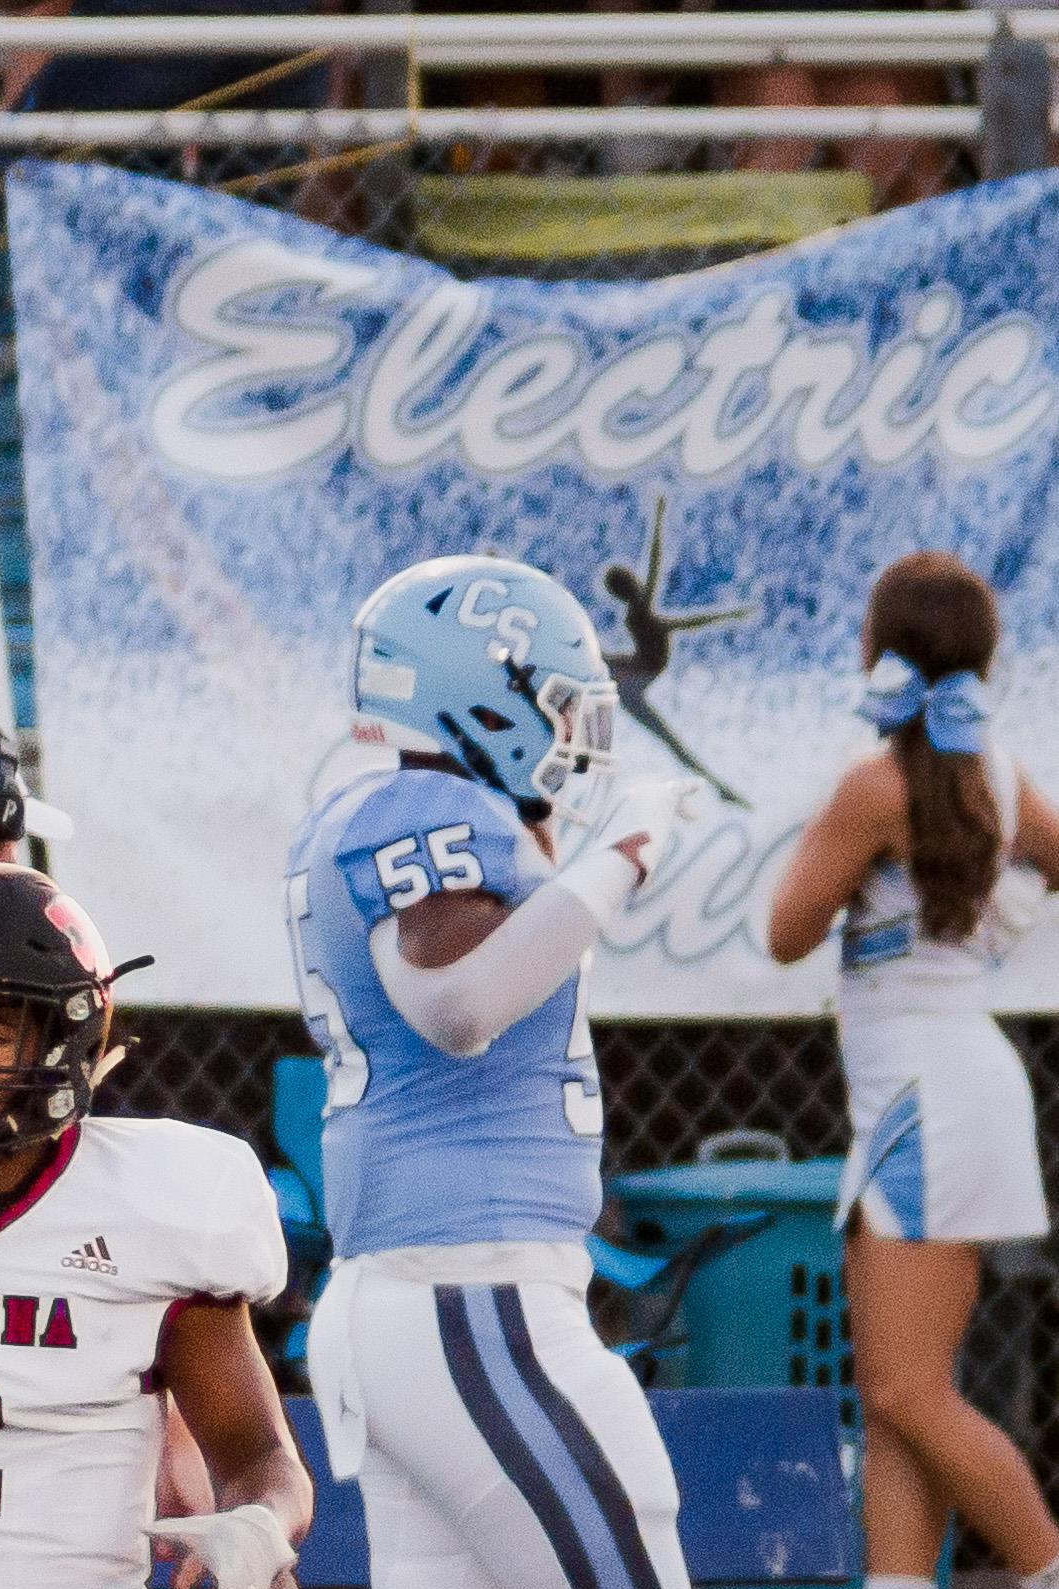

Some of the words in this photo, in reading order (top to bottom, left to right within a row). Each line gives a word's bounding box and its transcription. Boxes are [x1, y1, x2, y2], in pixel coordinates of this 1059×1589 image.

[150, 238, 1059, 480] Electric
[457, 578, 539, 665] CS
[375, 823, 484, 909] 55
[61, 1256, 118, 1276] adidas
